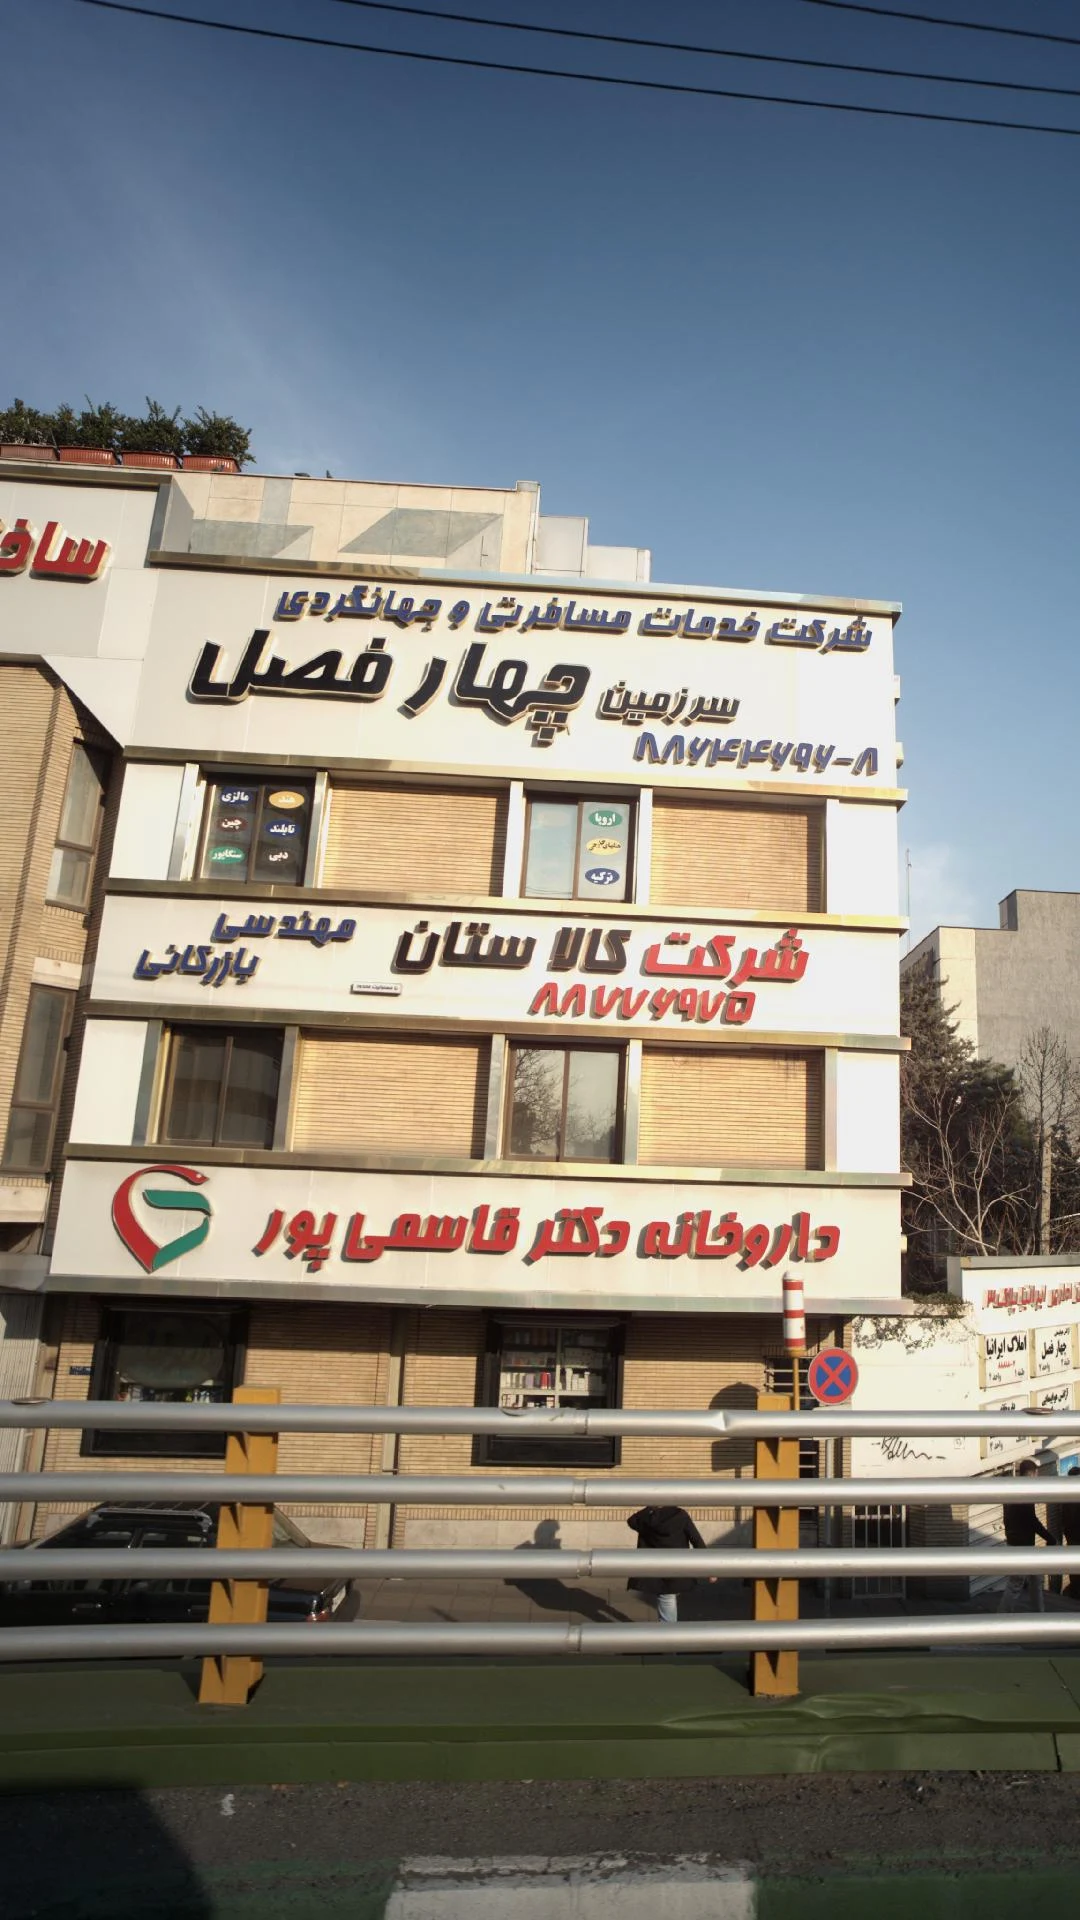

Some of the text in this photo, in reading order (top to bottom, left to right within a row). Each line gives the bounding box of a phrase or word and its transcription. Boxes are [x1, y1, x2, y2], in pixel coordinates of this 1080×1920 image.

[0, 518, 108, 580] ساخ
[275, 584, 873, 654] شرکت خدمات مسافرتی و جهانگردی
[190, 628, 740, 744] سرزمین چهار فصل
[221, 818, 242, 830] چین
[269, 824, 295, 835] تایلند
[590, 871, 614, 885] ترکیه
[212, 910, 357, 946] مهندسی
[134, 944, 261, 987] بازرگانی
[643, 928, 810, 986] شرکت
[530, 982, 756, 1023] ۸۸۷۷۶۹۷۵
[252, 1204, 840, 1271] داروخانه دکتر قاسمی پور
